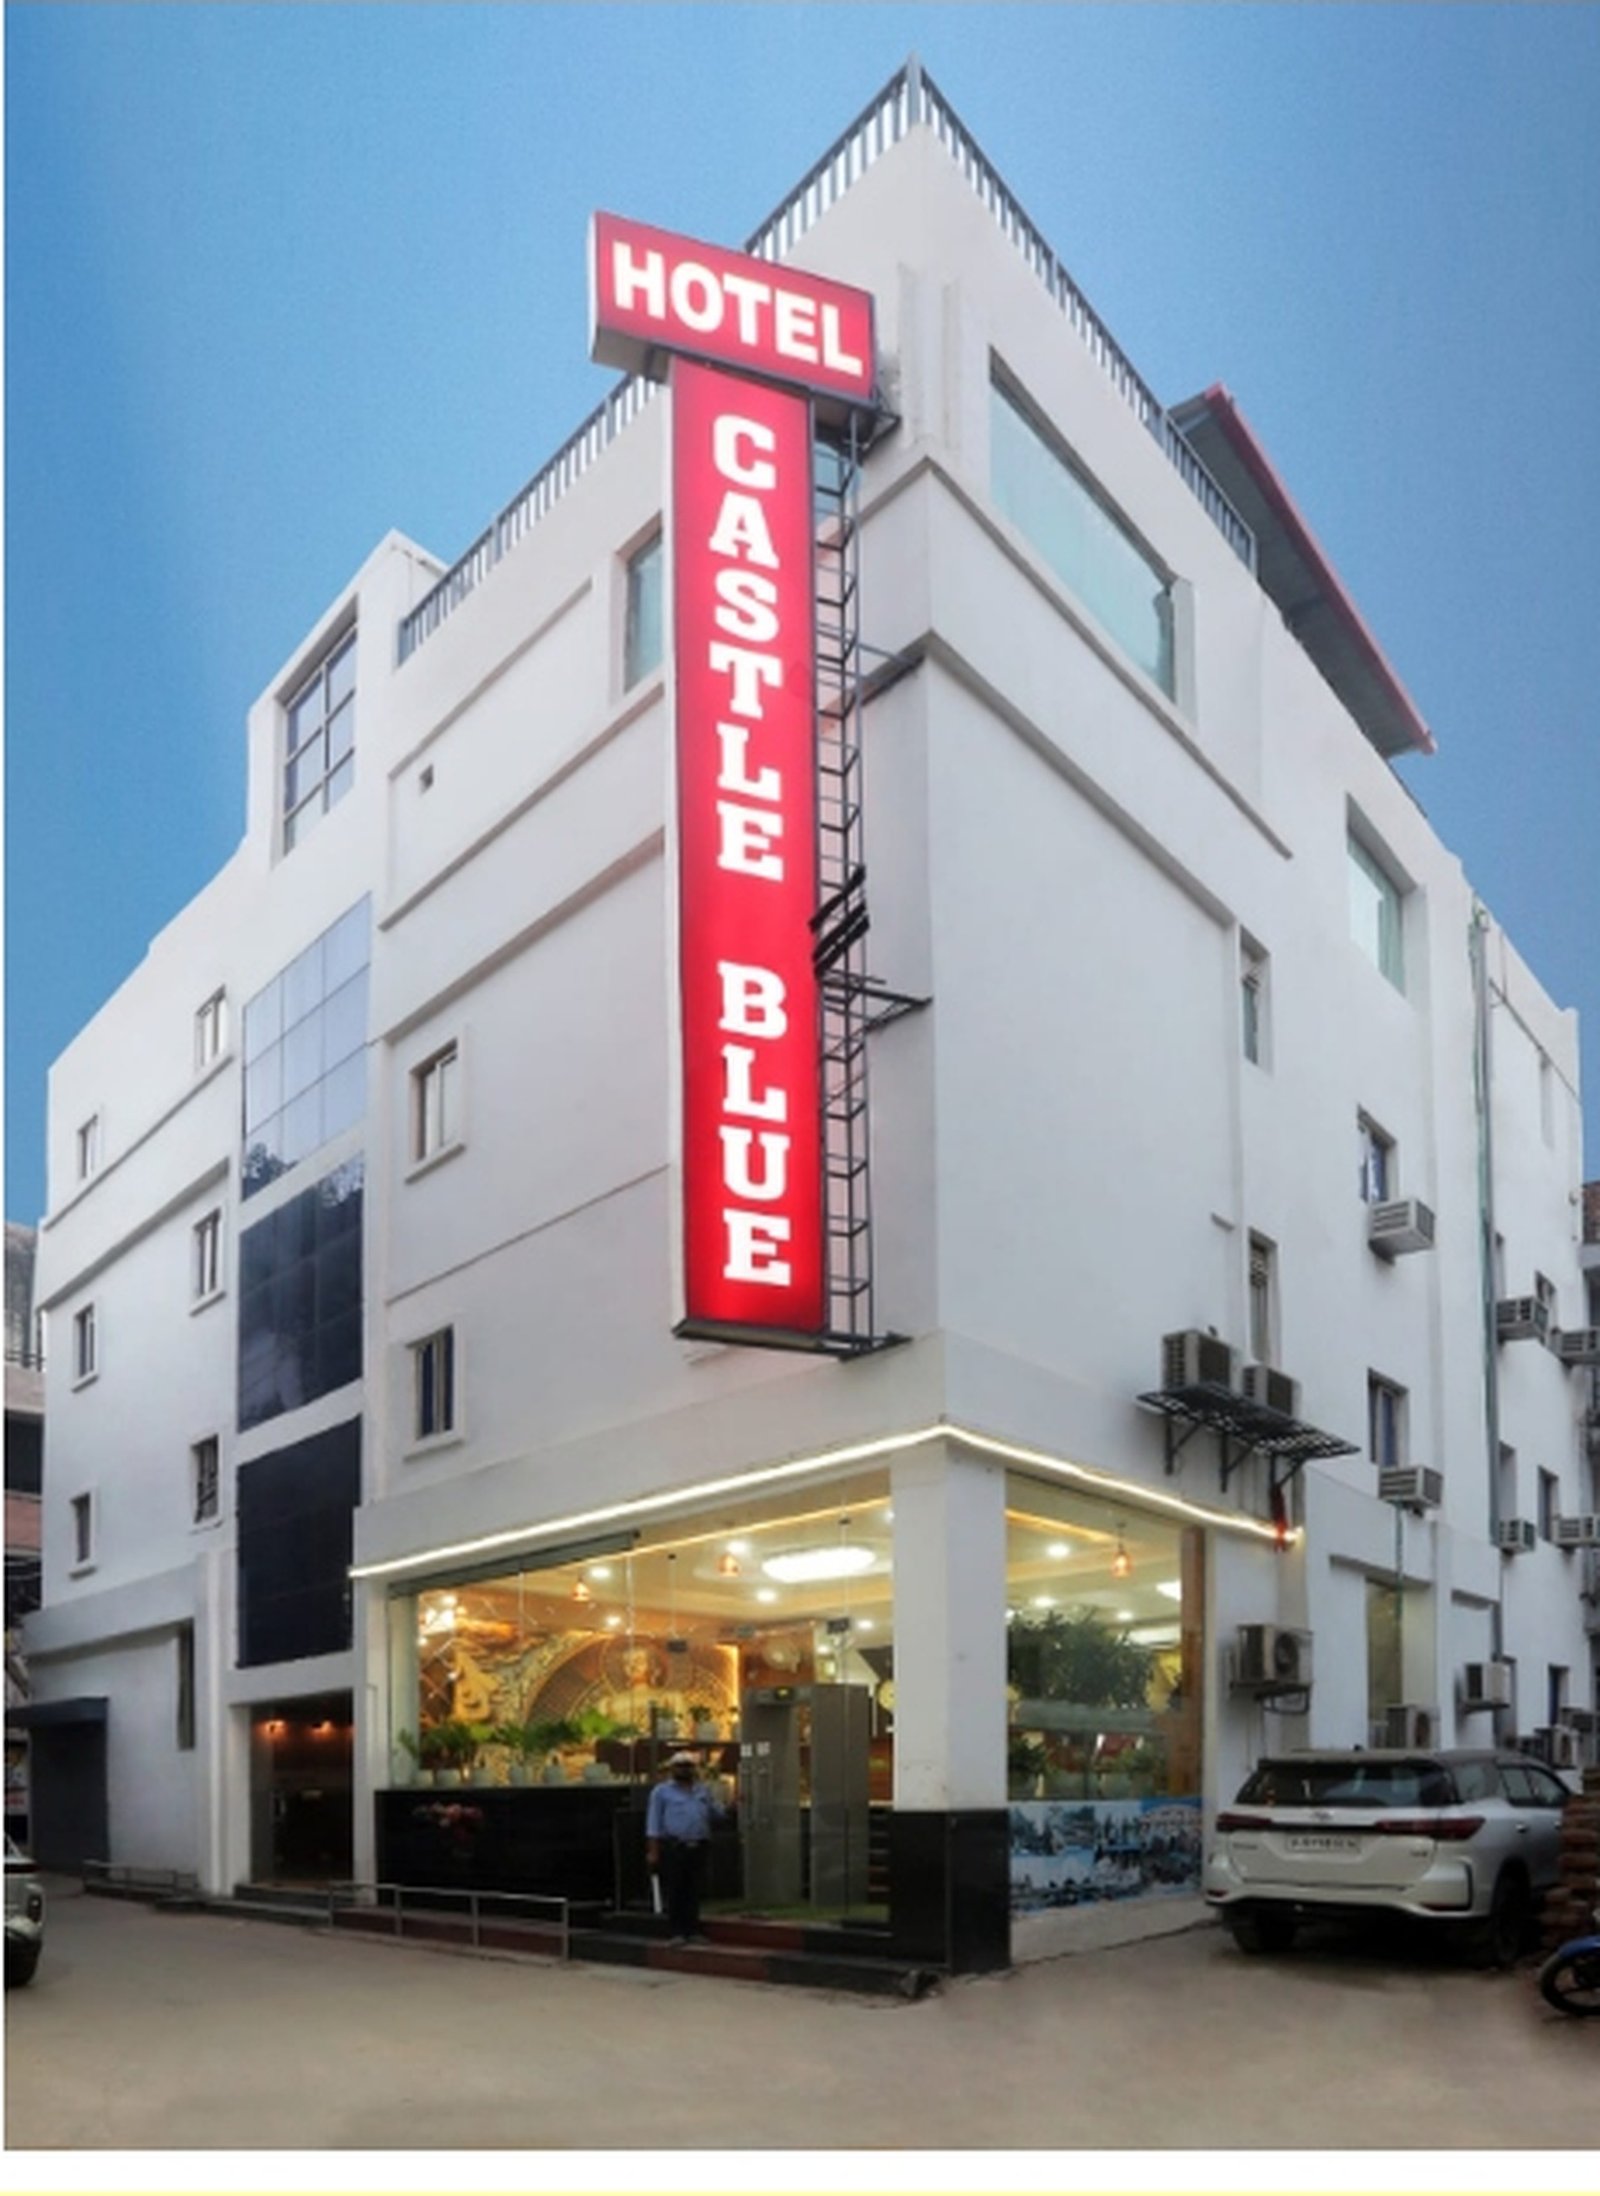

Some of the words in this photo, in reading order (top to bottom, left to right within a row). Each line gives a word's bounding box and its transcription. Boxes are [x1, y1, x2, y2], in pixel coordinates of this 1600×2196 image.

[612, 239, 863, 377] HOTEL
[709, 414, 784, 882] CASTLE
[717, 960, 791, 1287] BLUE
